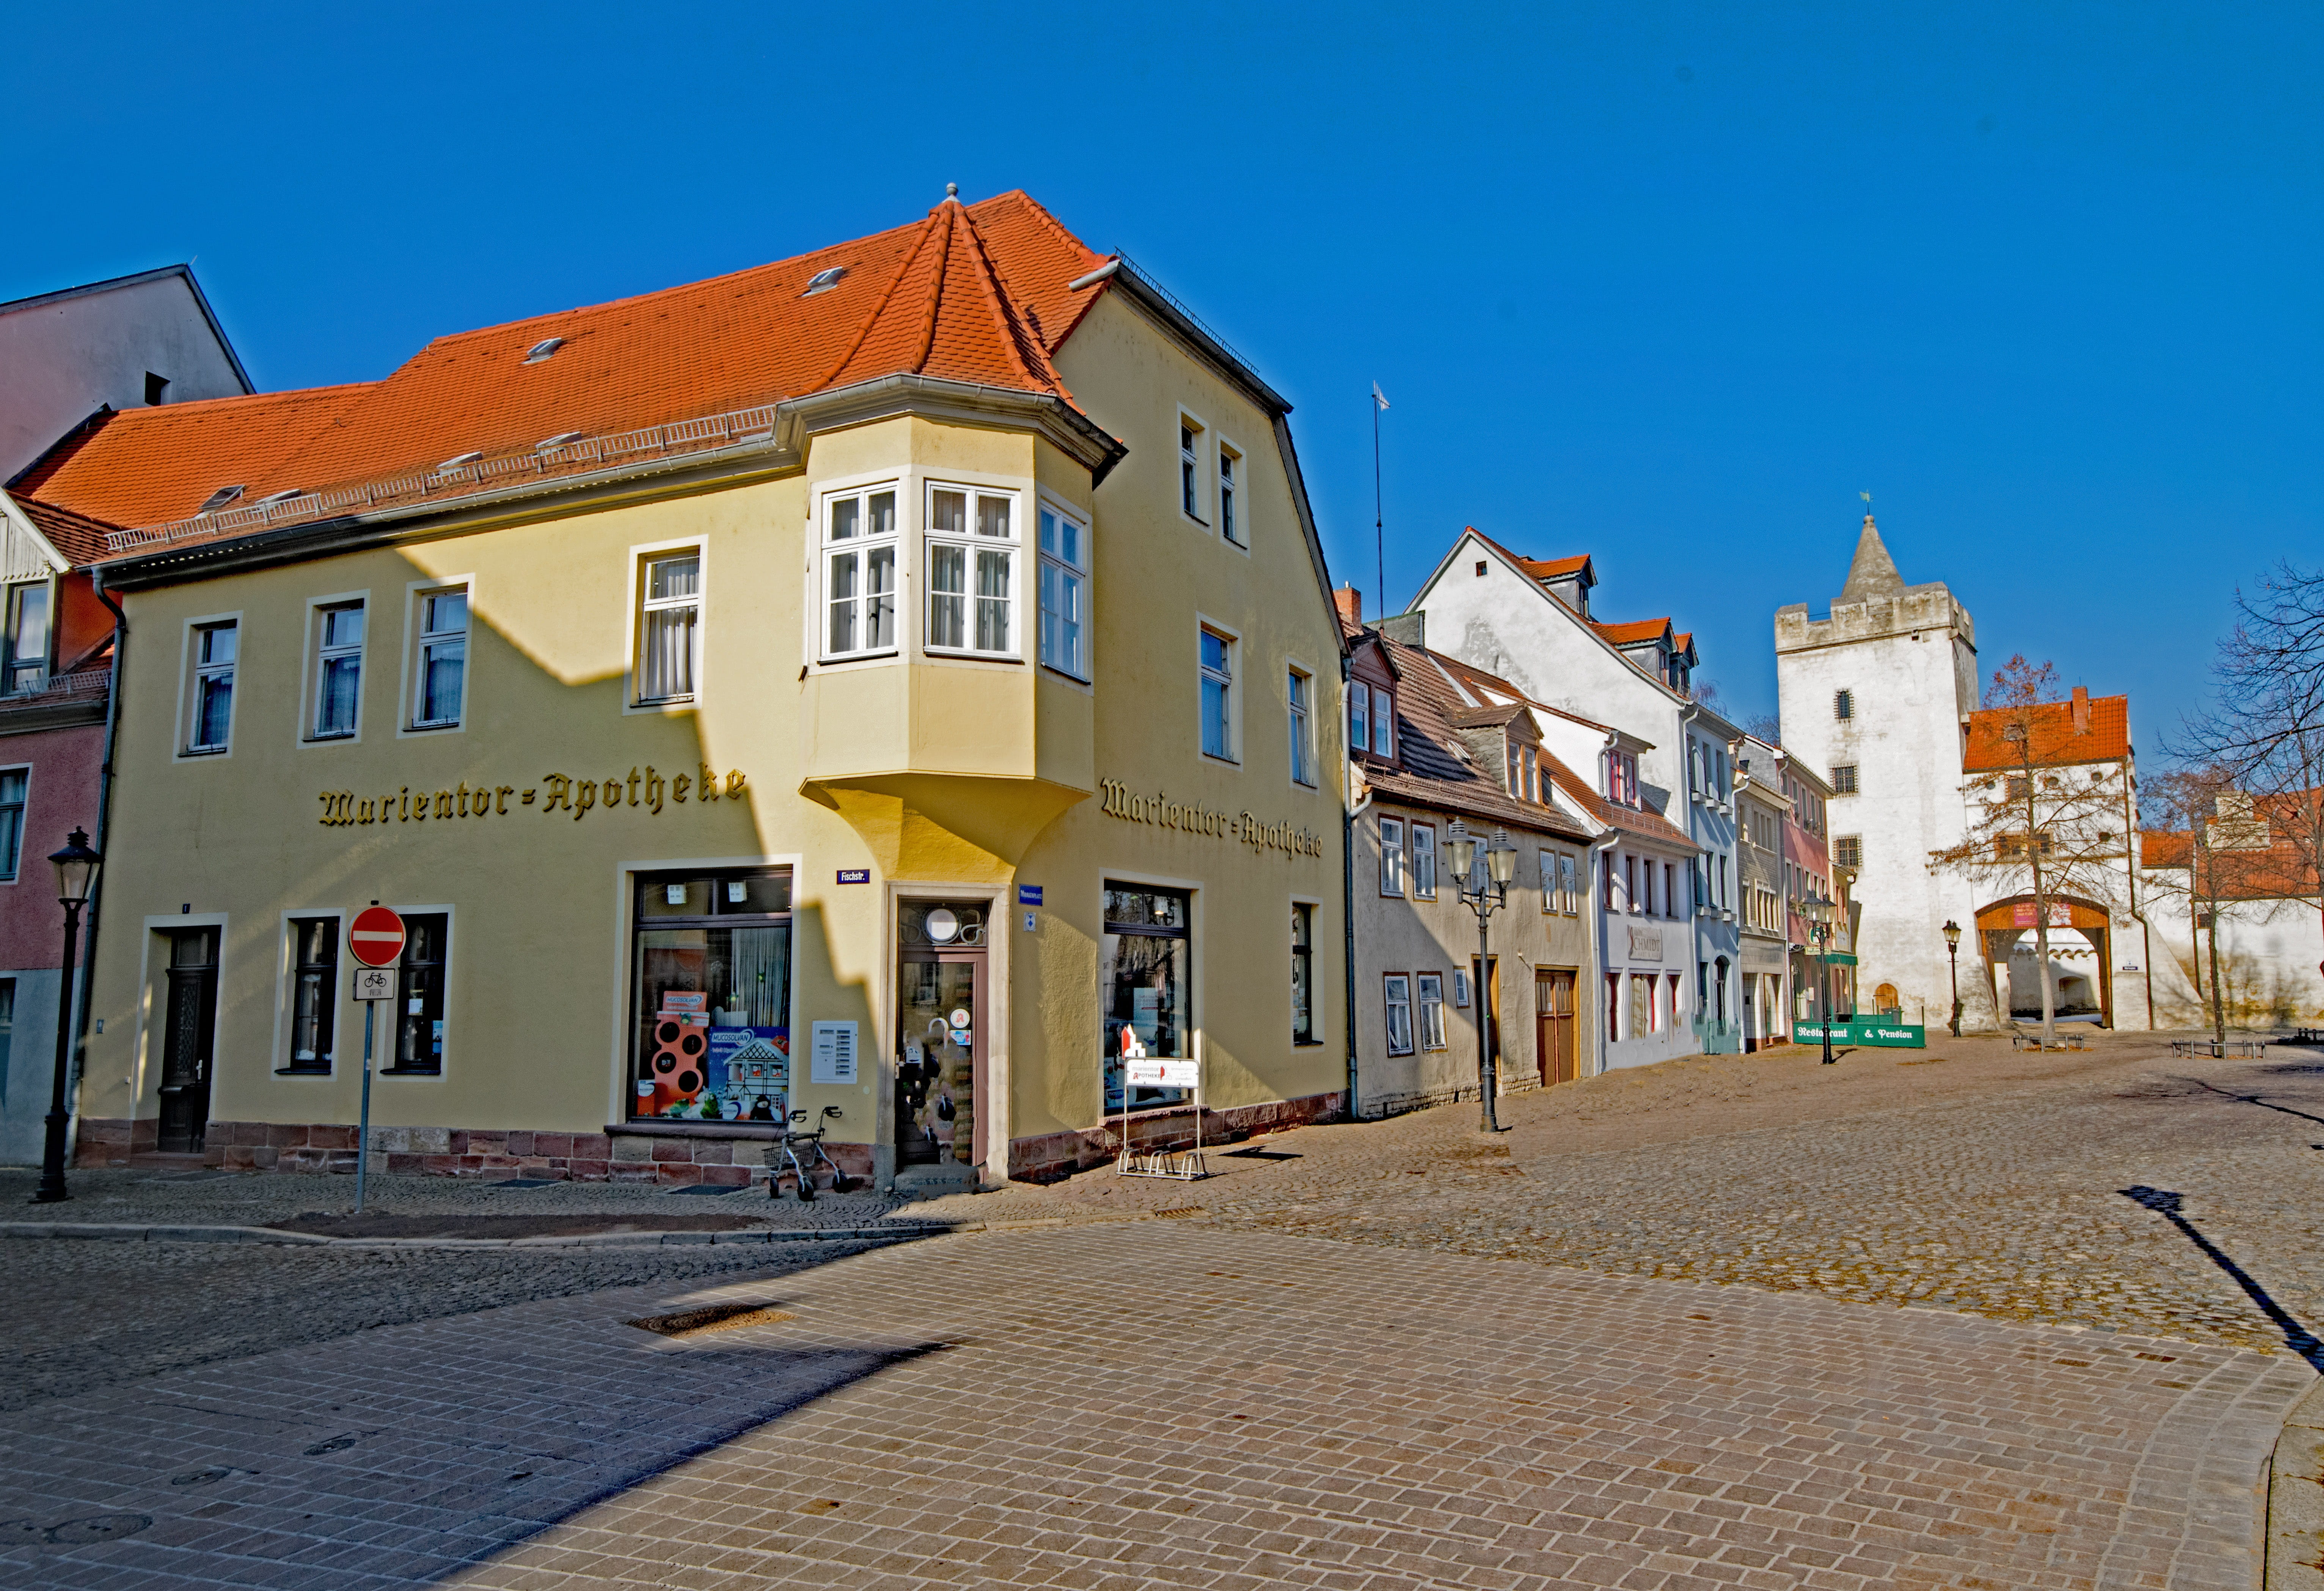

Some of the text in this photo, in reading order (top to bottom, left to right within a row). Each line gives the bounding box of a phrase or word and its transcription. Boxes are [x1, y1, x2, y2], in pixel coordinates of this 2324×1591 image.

[841, 872, 865, 881] Fischstr.
[1798, 1027, 1913, 1039] Restarant & Pension
